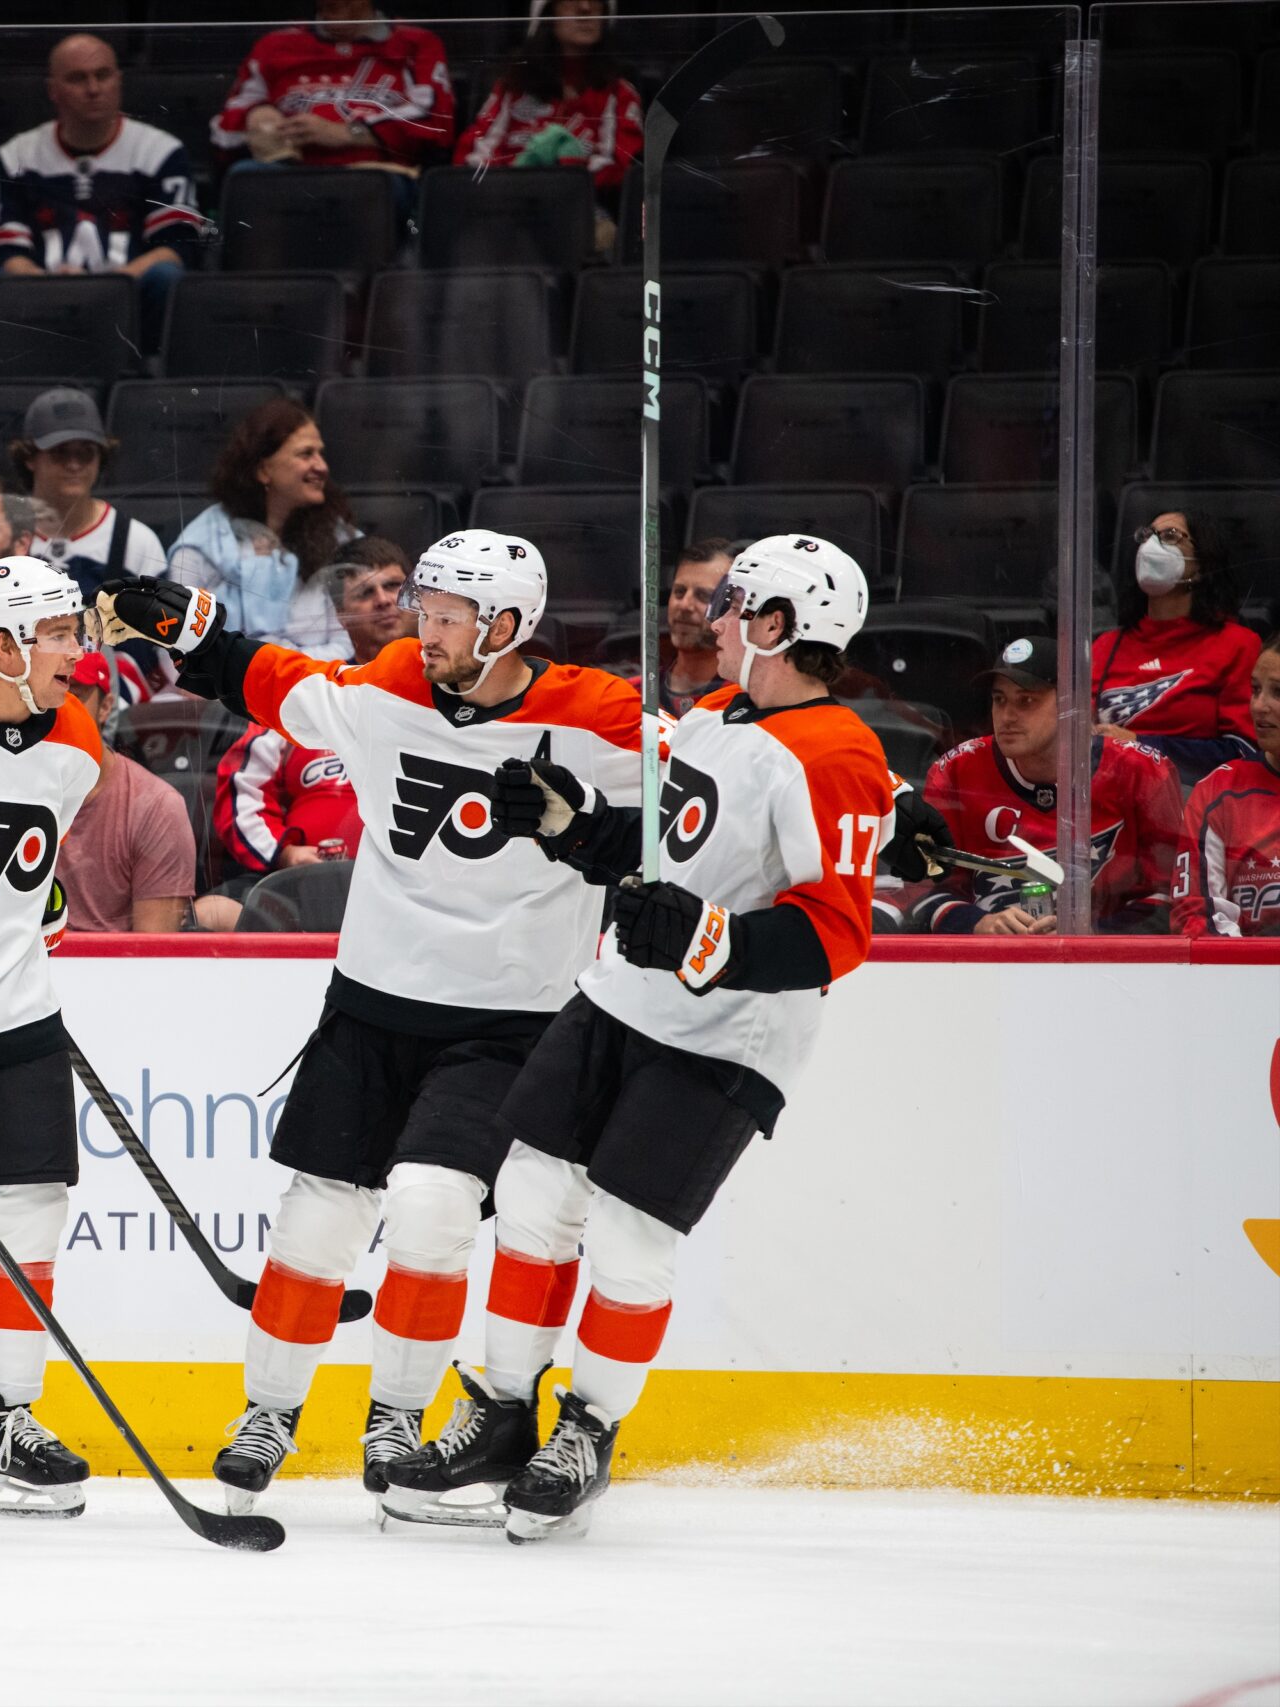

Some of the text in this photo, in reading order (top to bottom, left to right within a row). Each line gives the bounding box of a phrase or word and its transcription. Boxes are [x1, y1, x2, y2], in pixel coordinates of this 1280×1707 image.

[644, 279, 661, 421] CCM
[834, 812, 881, 878] 17
[984, 805, 1022, 844] C
[1172, 851, 1190, 899] 3
[78, 1068, 288, 1160] chn
